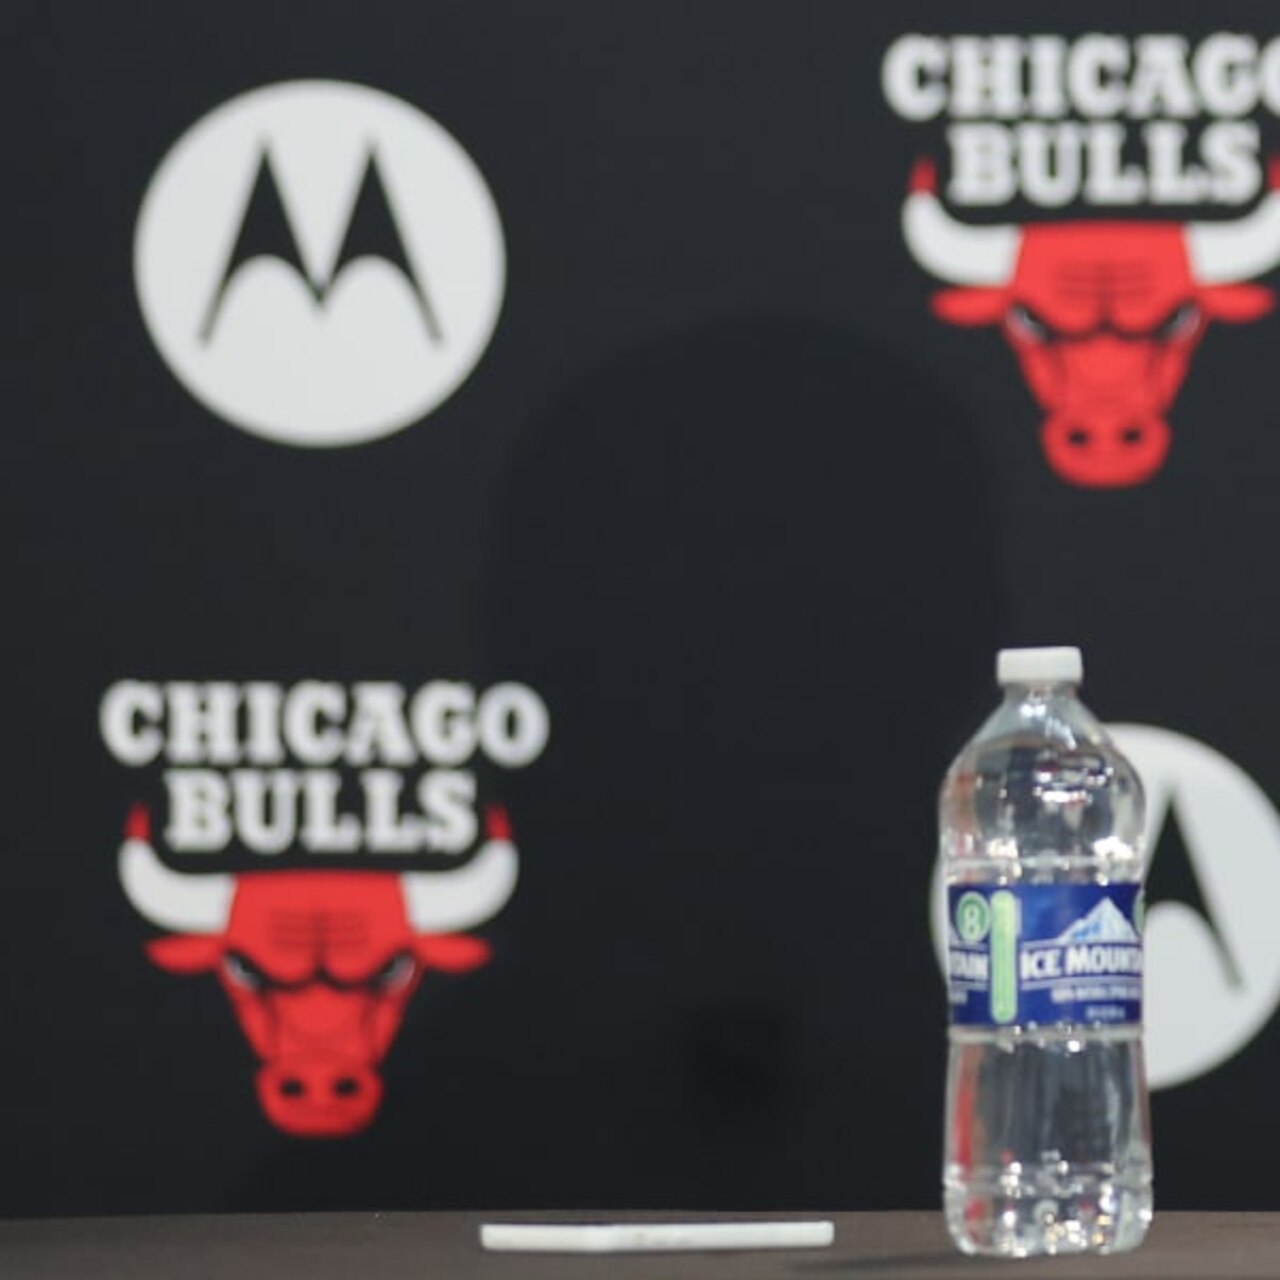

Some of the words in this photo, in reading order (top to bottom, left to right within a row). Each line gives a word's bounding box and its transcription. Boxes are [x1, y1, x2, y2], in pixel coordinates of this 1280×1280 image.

[947, 121, 1264, 206] BULLS
[101, 681, 548, 765] CHICAGO
[163, 768, 480, 853] BULLS
[1020, 949, 1063, 980] ICE
